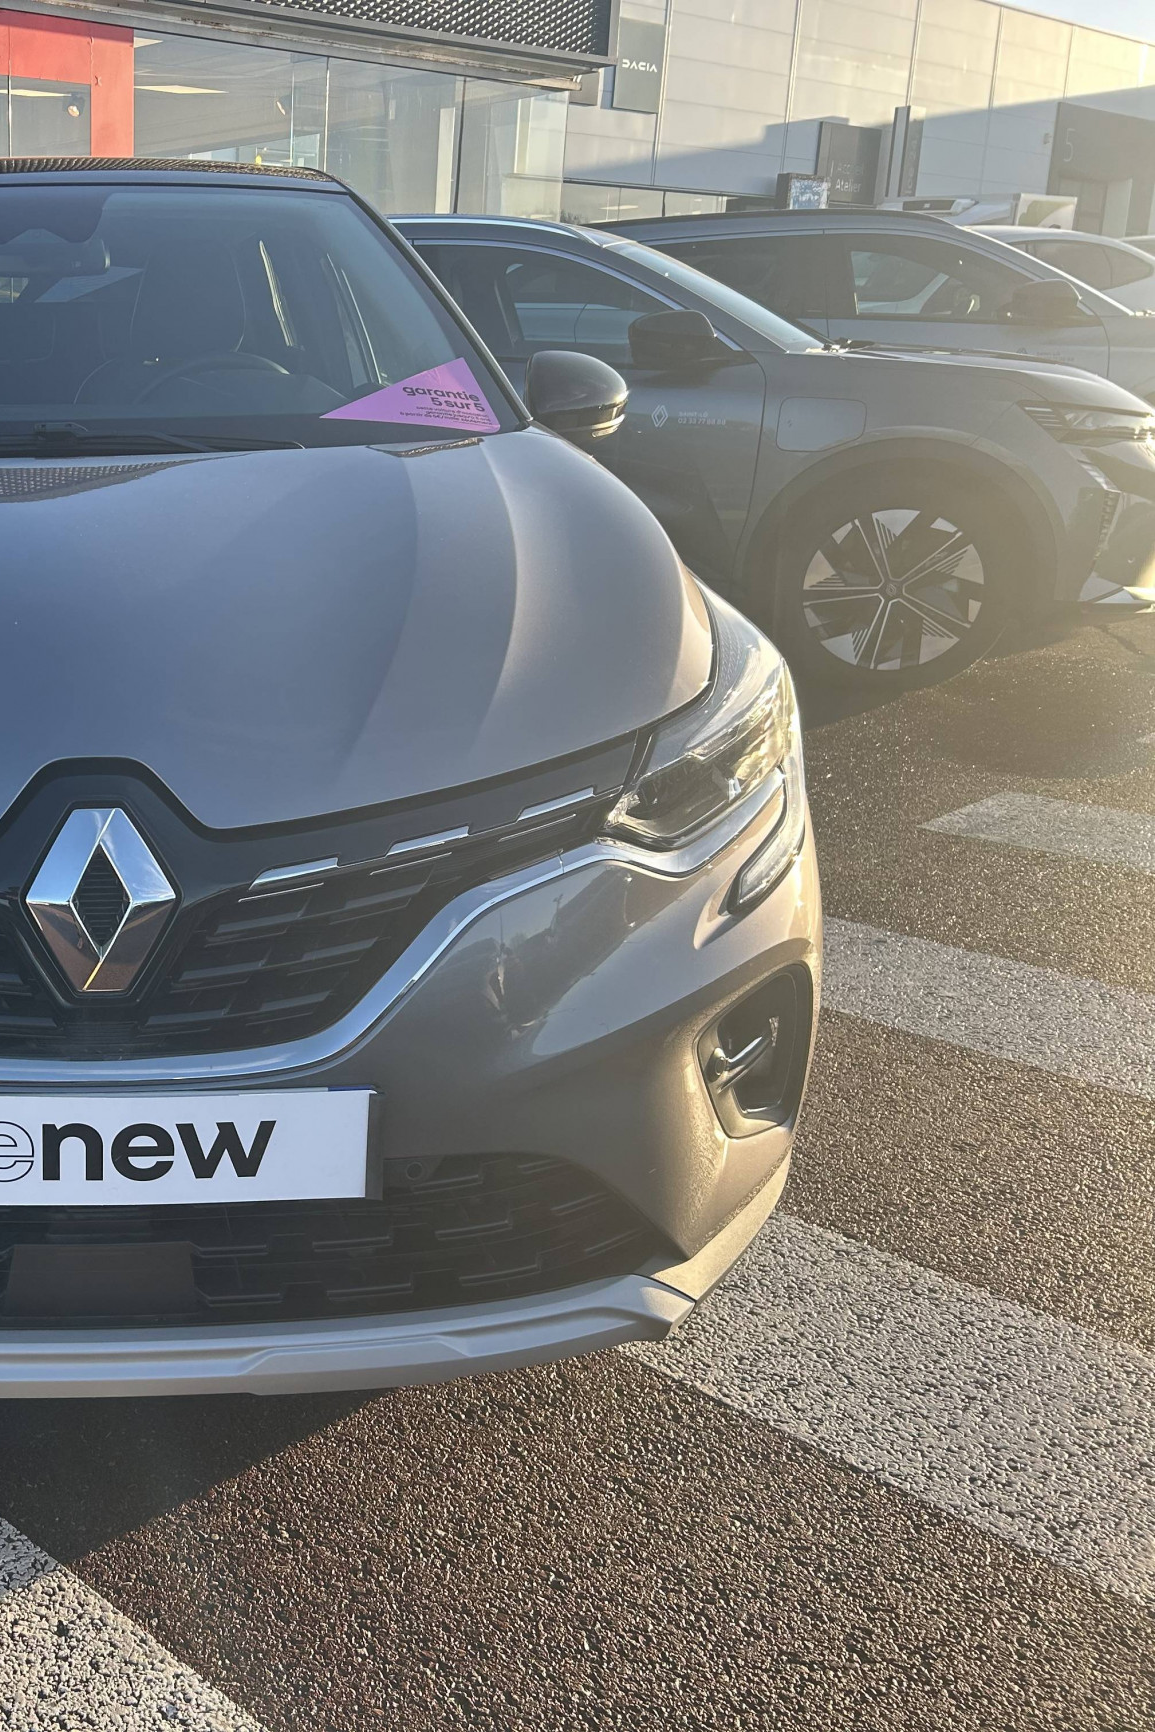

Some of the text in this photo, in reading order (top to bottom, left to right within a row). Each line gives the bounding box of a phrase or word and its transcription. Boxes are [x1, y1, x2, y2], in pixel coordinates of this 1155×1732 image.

[621, 58, 658, 73] DACIA
[1063, 128, 1076, 162] 5
[835, 178, 862, 193] Atelier
[403, 386, 479, 401] garantie
[430, 397, 486, 412] 5 sur 5
